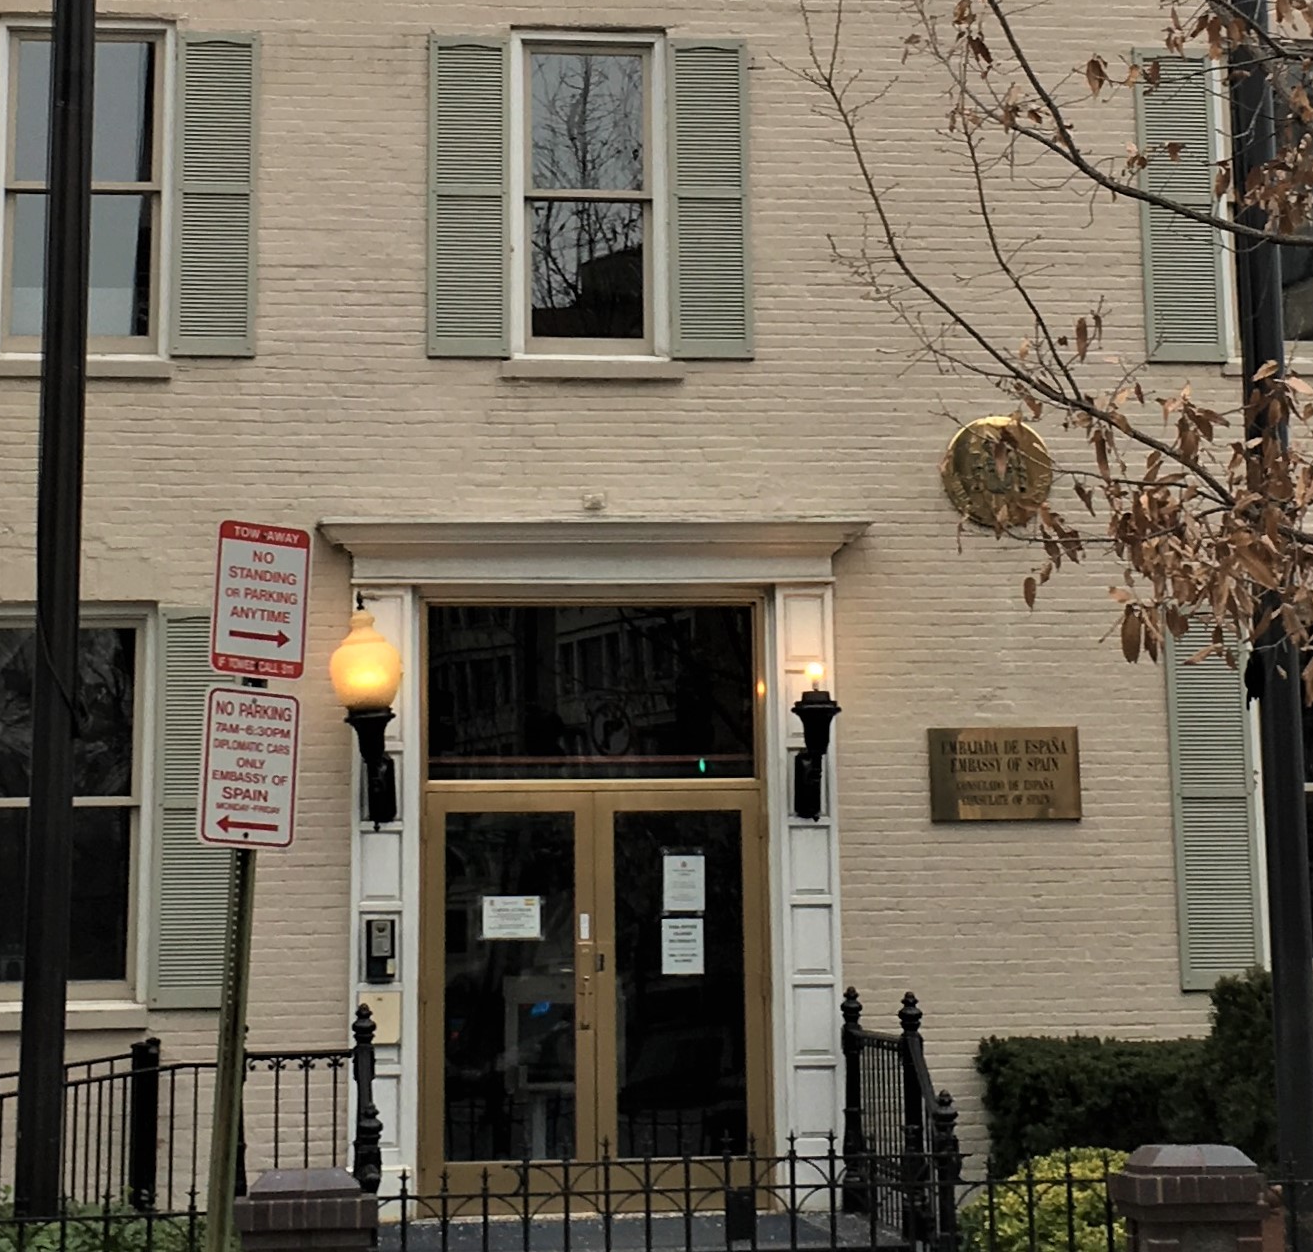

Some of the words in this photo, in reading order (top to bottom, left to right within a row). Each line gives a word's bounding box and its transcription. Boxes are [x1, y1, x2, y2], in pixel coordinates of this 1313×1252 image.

[252, 550, 275, 564] NO
[228, 565, 297, 585] STANDING
[225, 588, 240, 598] OR
[244, 588, 298, 605] PARKING
[230, 606, 291, 624] ANYTIME
[215, 700, 235, 716] NO
[239, 702, 292, 722] PARKING
[215, 722, 291, 739] 7AM-6:30PM
[213, 738, 264, 753] DIPLOMATIC
[267, 743, 290, 756] CARS
[941, 740, 999, 755] EMBAJADA
[1004, 740, 1019, 755] DE
[1024, 736, 1067, 755] ESPAÑA
[236, 757, 265, 769] ONLY
[950, 757, 1002, 773] EMBASSY
[1007, 757, 1022, 773] OF
[1027, 757, 1059, 772] SPAIN
[212, 769, 268, 784] EMBASSY
[272, 775, 288, 786] OF
[1009, 780, 1019, 791] DE
[222, 786, 269, 803] SPAIN
